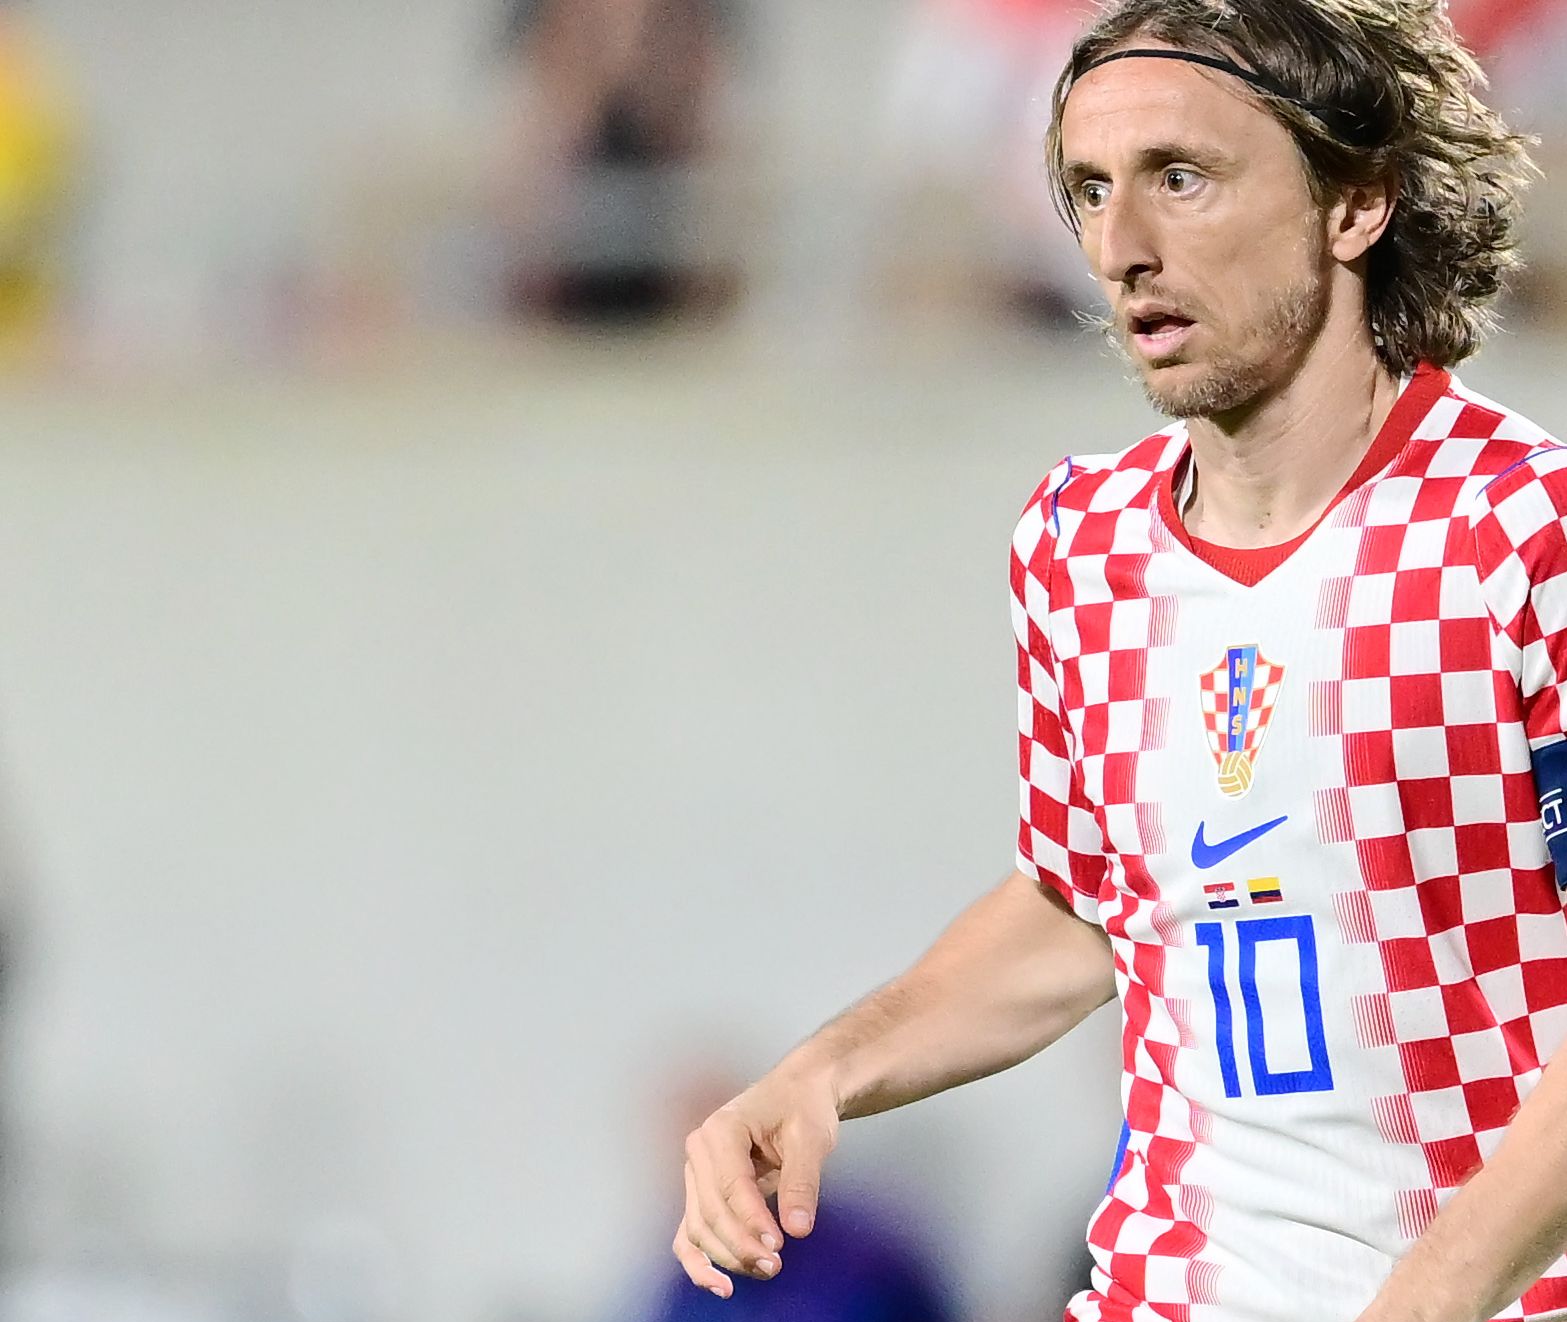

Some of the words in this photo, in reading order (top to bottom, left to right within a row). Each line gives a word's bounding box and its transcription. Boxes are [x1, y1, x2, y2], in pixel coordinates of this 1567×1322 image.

[1231, 657, 1248, 736] HNS
[1540, 798, 1563, 834] CT
[1195, 914, 1334, 1099] 10
